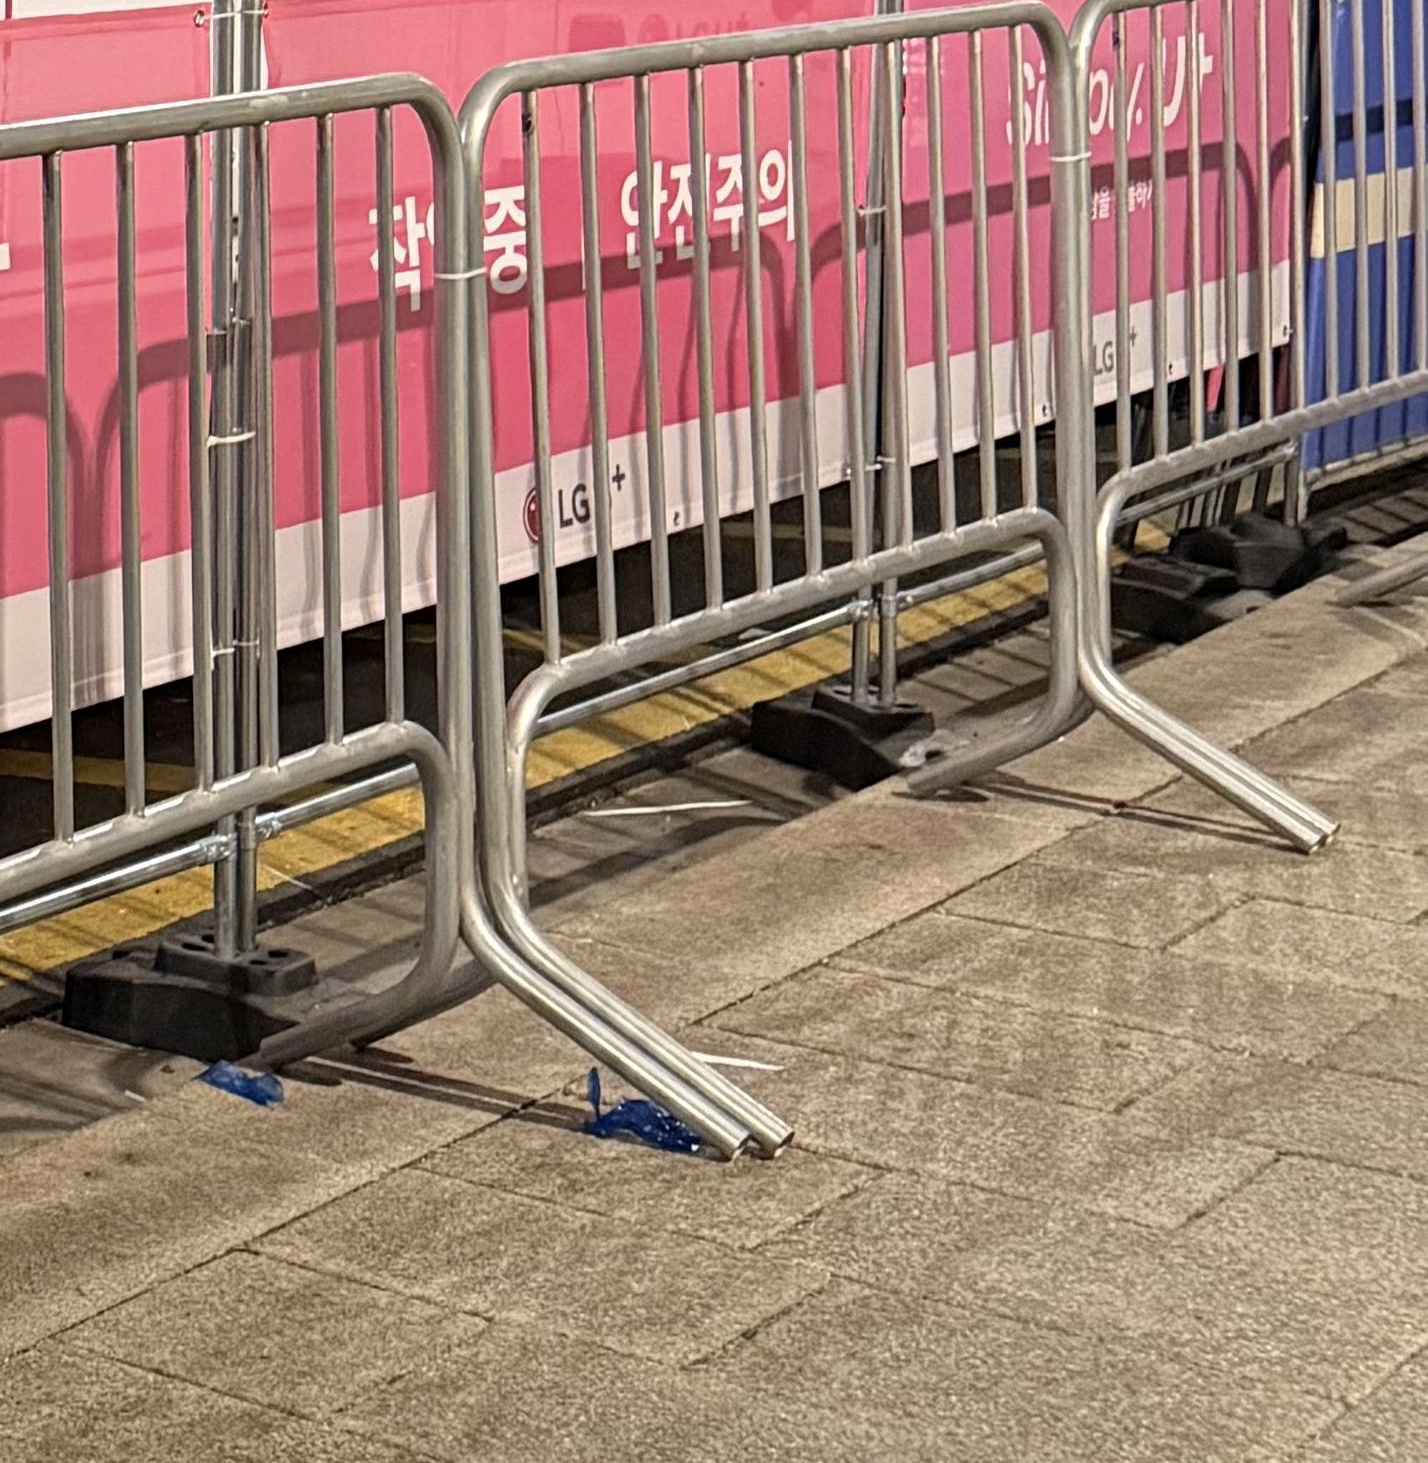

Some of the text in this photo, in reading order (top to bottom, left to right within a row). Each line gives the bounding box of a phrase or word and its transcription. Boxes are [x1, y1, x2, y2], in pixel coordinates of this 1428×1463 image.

[368, 184, 527, 311] 작중
[1092, 325, 1138, 376] LG+
[558, 462, 626, 529] LG+
